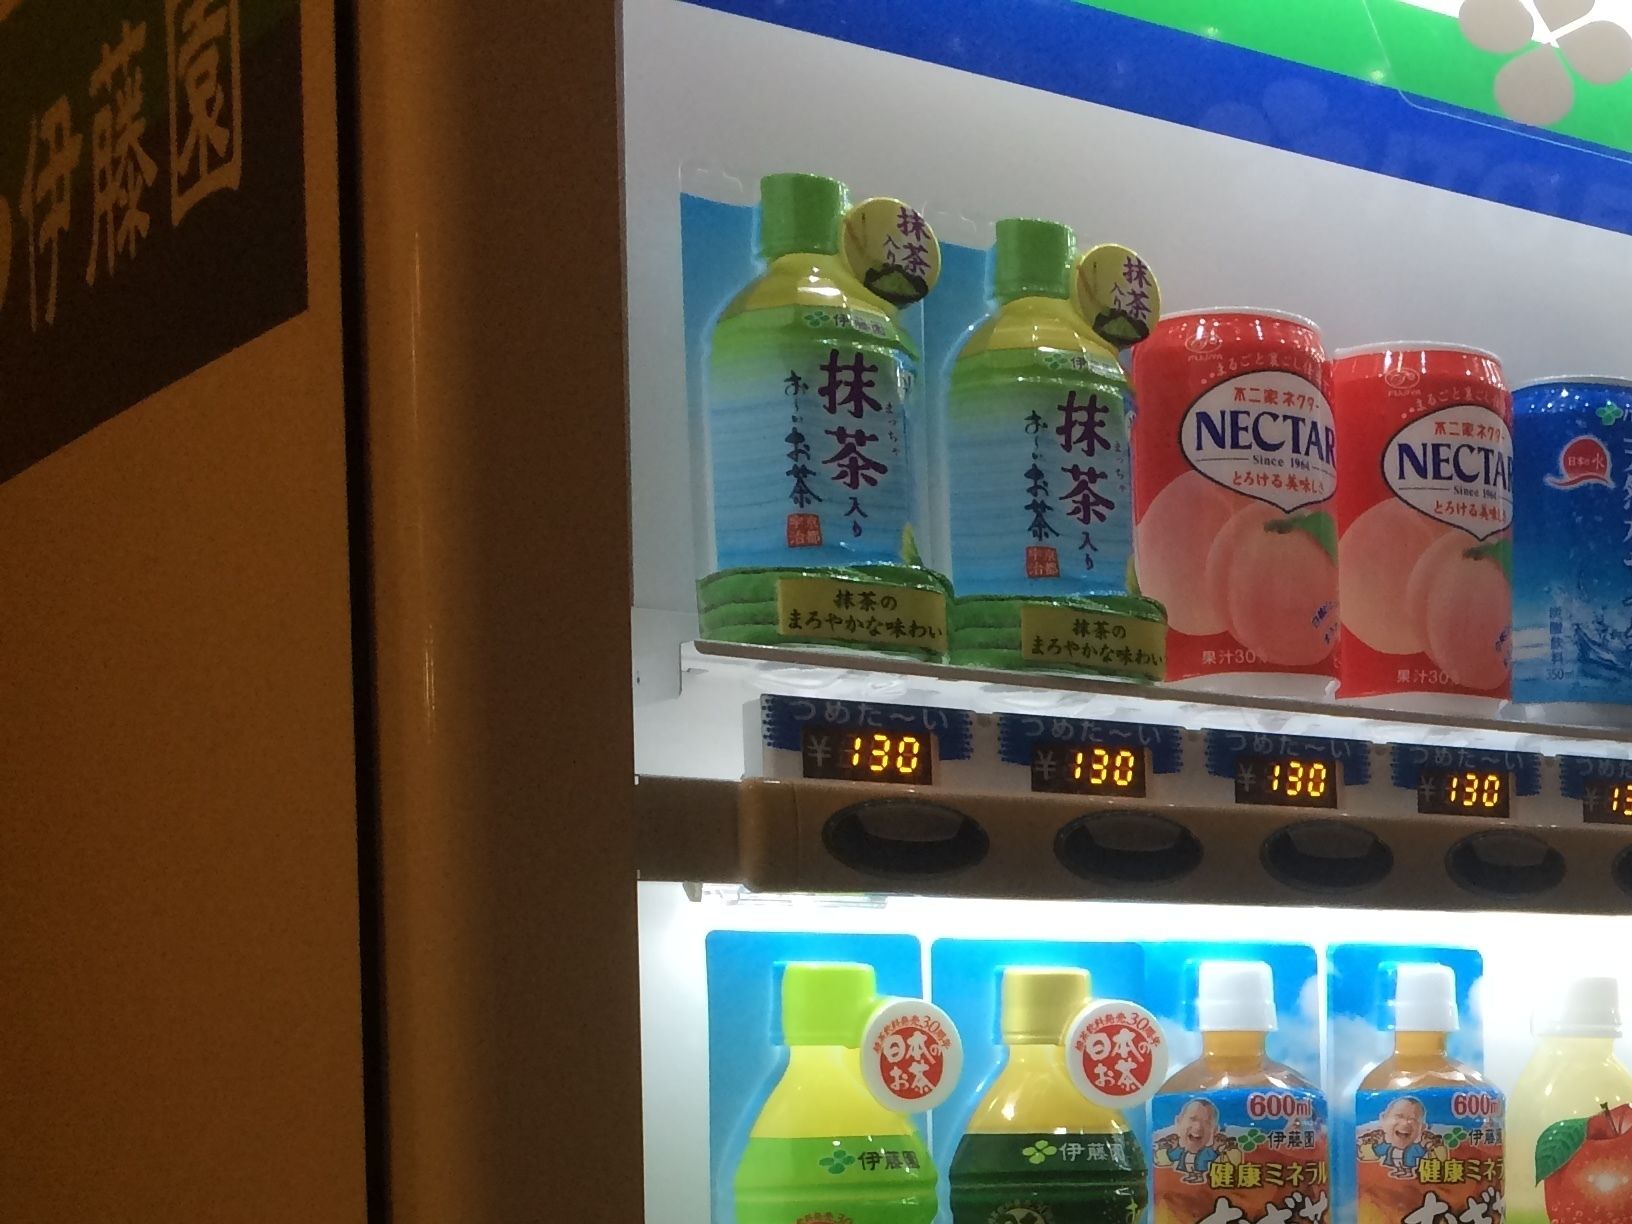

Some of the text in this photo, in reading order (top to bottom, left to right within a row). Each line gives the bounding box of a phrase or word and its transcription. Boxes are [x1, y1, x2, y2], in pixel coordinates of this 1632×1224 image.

[0, 0, 242, 334] 伊藤園
[831, 589, 899, 613] 抹茶の
[787, 608, 944, 641] まろやかな味わい
[1071, 618, 1127, 640] 抹茶の
[1030, 635, 1166, 668] まろやかな味わい
[850, 733, 921, 775] 130
[1072, 747, 1136, 788] 130
[1269, 759, 1328, 798] 130
[1447, 771, 1502, 808] 130
[888, 1060, 936, 1095] お茶
[1093, 1060, 1142, 1094] お茶
[1247, 1094, 1313, 1121] 600ml
[1059, 1142, 1129, 1164] 伊藤園
[1267, 1129, 1316, 1151] 伊藤園
[857, 1149, 921, 1172] 伊藤園
[1209, 1158, 1328, 1190] 健康ミネラル
